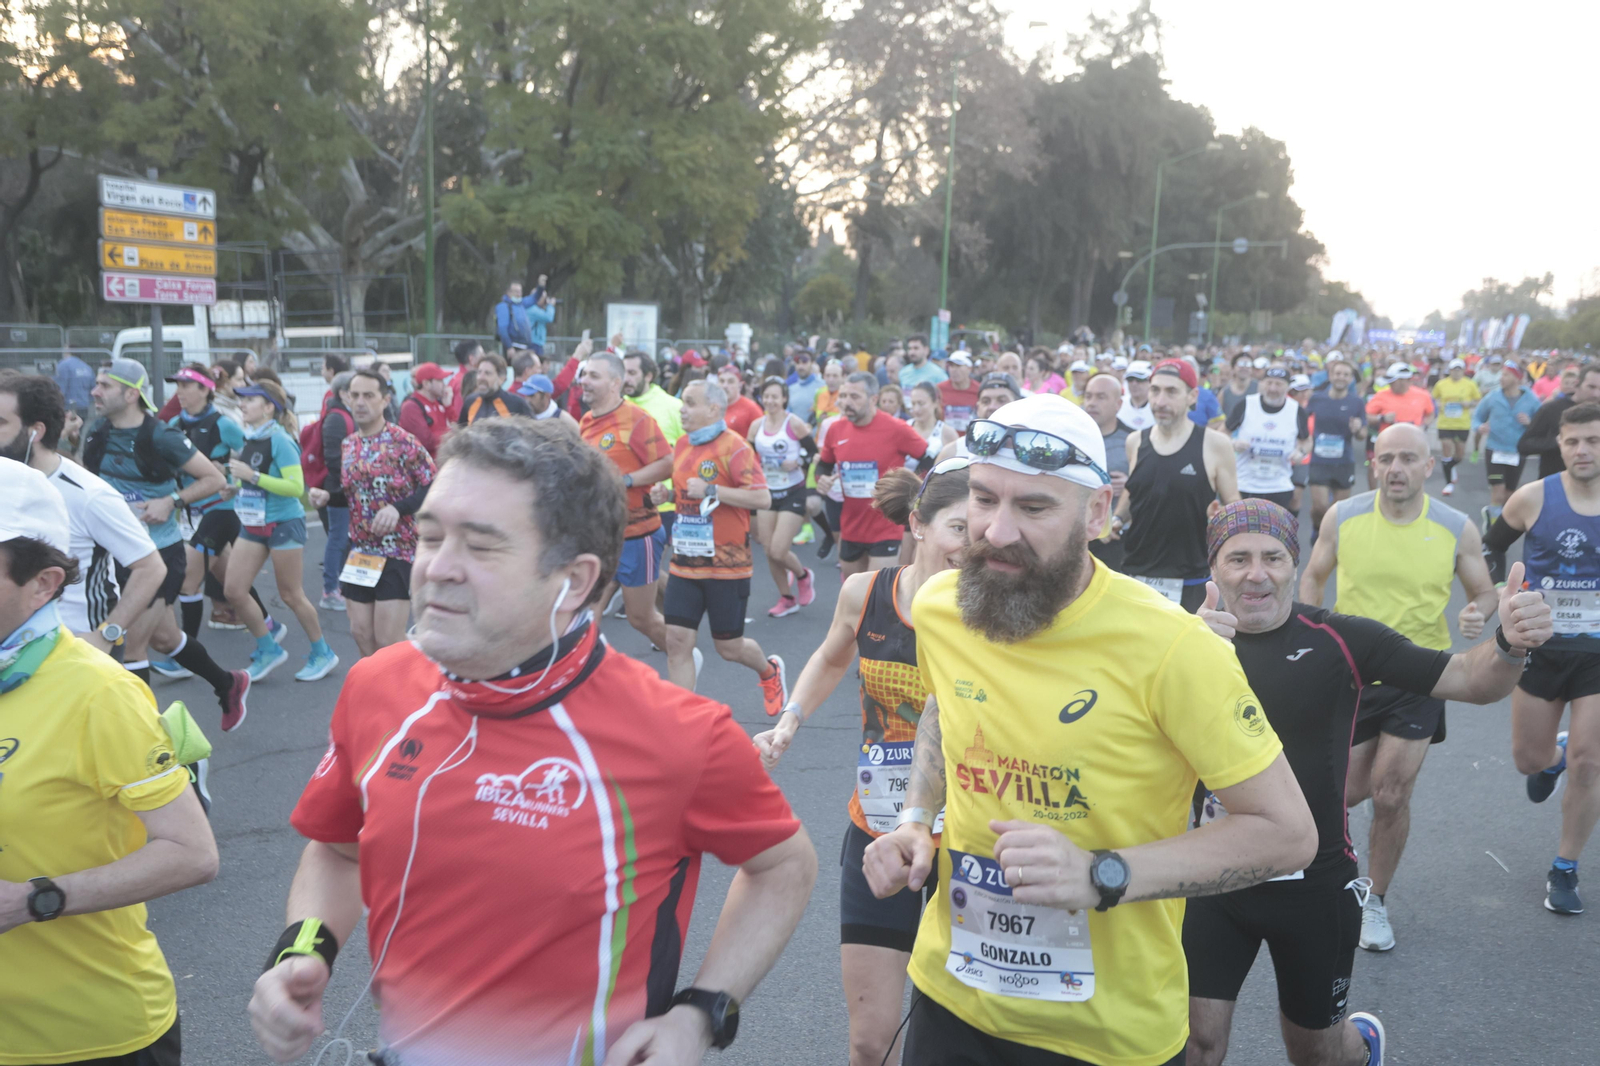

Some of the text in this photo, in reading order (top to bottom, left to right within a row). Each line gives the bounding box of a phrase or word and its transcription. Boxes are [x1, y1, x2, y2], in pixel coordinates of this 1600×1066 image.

[107, 192, 136, 204] Virgen
[140, 195, 155, 206] del
[108, 224, 126, 234] San
[170, 259, 180, 270] de
[185, 260, 213, 272] Armas
[154, 288, 213, 302] Torre Sevilla
[682, 516, 708, 524] ZURICH
[1555, 579, 1597, 589] ZURICH
[474, 786, 525, 807] IBIZA
[492, 807, 549, 830] SEVILLA
[1033, 810, 1088, 821] 20-02-2022
[987, 910, 1036, 936] 7967
[980, 942, 1052, 966] GONZALO
